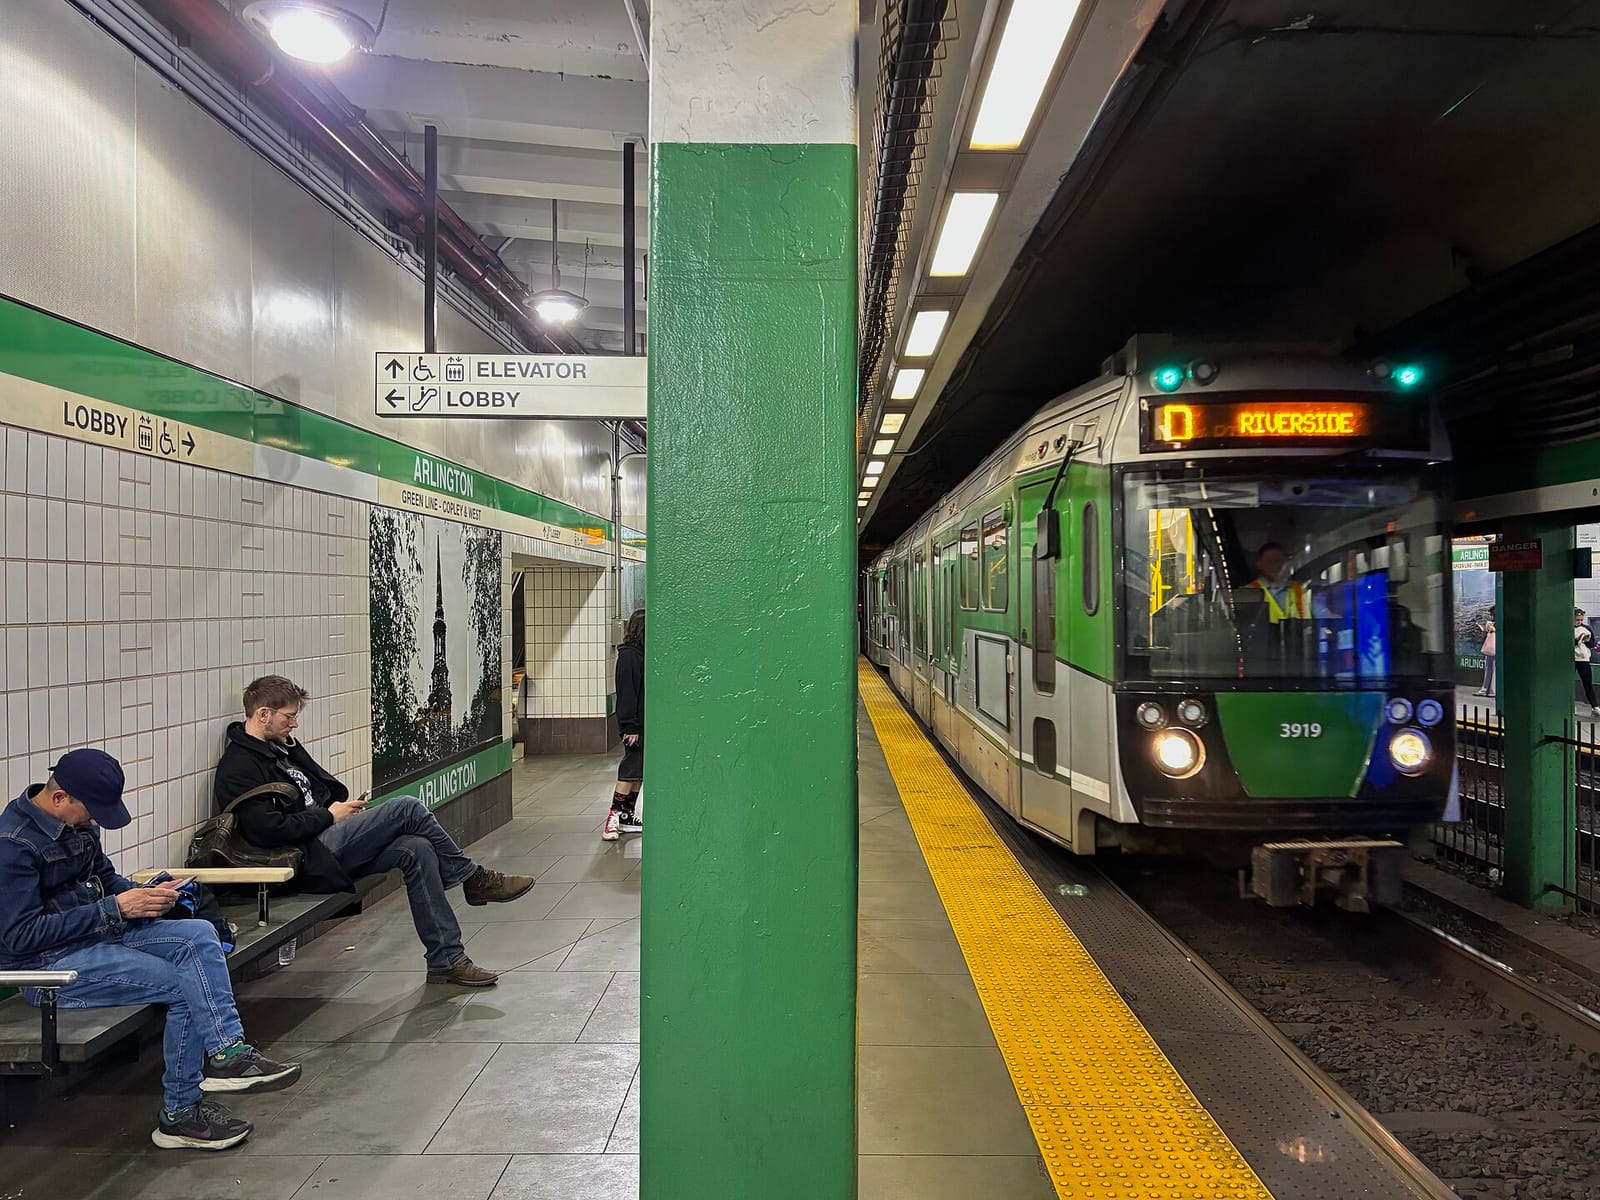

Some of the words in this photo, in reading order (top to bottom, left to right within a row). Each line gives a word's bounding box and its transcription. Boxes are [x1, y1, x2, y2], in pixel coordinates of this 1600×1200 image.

[477, 361, 587, 379] ELEVATOR
[446, 390, 520, 408] LOBBY
[63, 401, 129, 438] LOBBY
[1163, 404, 1194, 441] D
[1240, 412, 1354, 434] RIVERSIDE
[413, 456, 474, 498] ARLINGTON
[401, 489, 424, 508] GREEN
[424, 495, 438, 511] LINE
[442, 500, 464, 517] COPLEY
[468, 506, 482, 521] WEST
[1460, 549, 1488, 561] ARLINGT
[1491, 542, 1537, 552] DANGER
[1280, 723, 1322, 738] 3919
[418, 760, 476, 807] ARLINGTON
